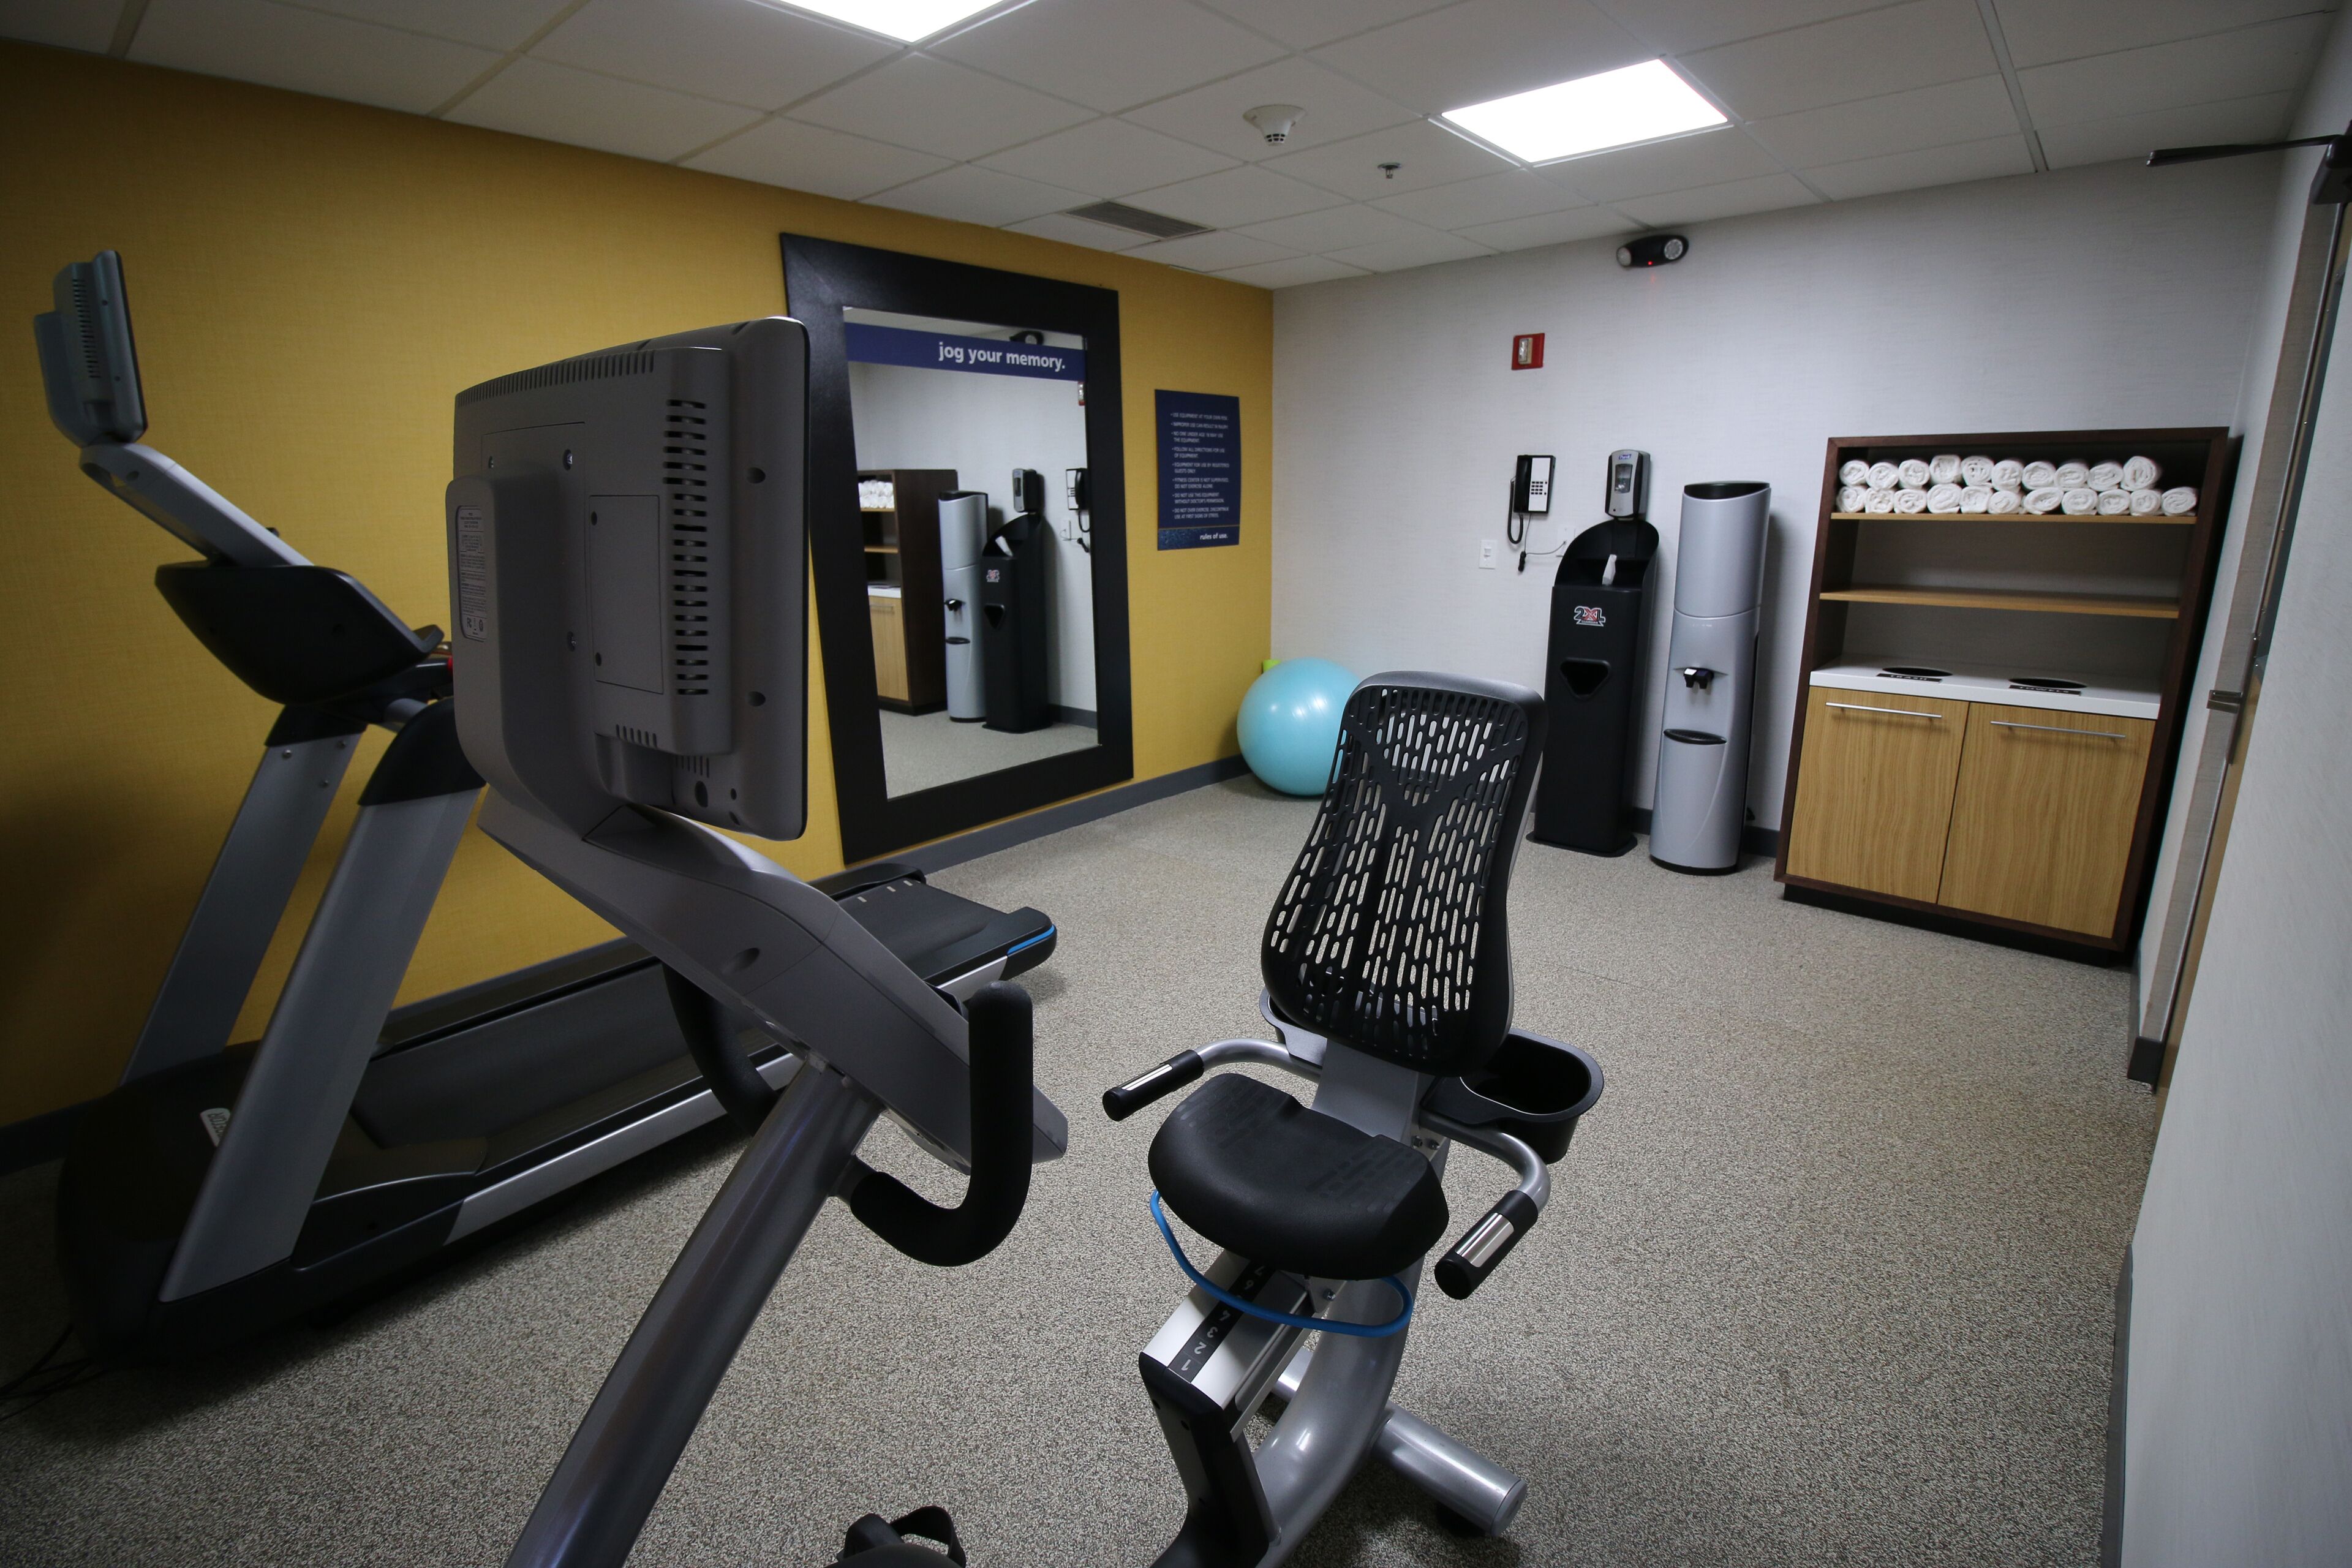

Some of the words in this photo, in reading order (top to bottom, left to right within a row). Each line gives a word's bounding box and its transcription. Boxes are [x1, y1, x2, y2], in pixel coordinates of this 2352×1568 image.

[938, 342, 964, 363] jog
[968, 347, 1003, 364] your
[1006, 353, 1066, 372] memory.
[1207, 1327, 1218, 1338] 3
[1194, 1341, 1207, 1354] 2
[1181, 1359, 1191, 1371] 1
